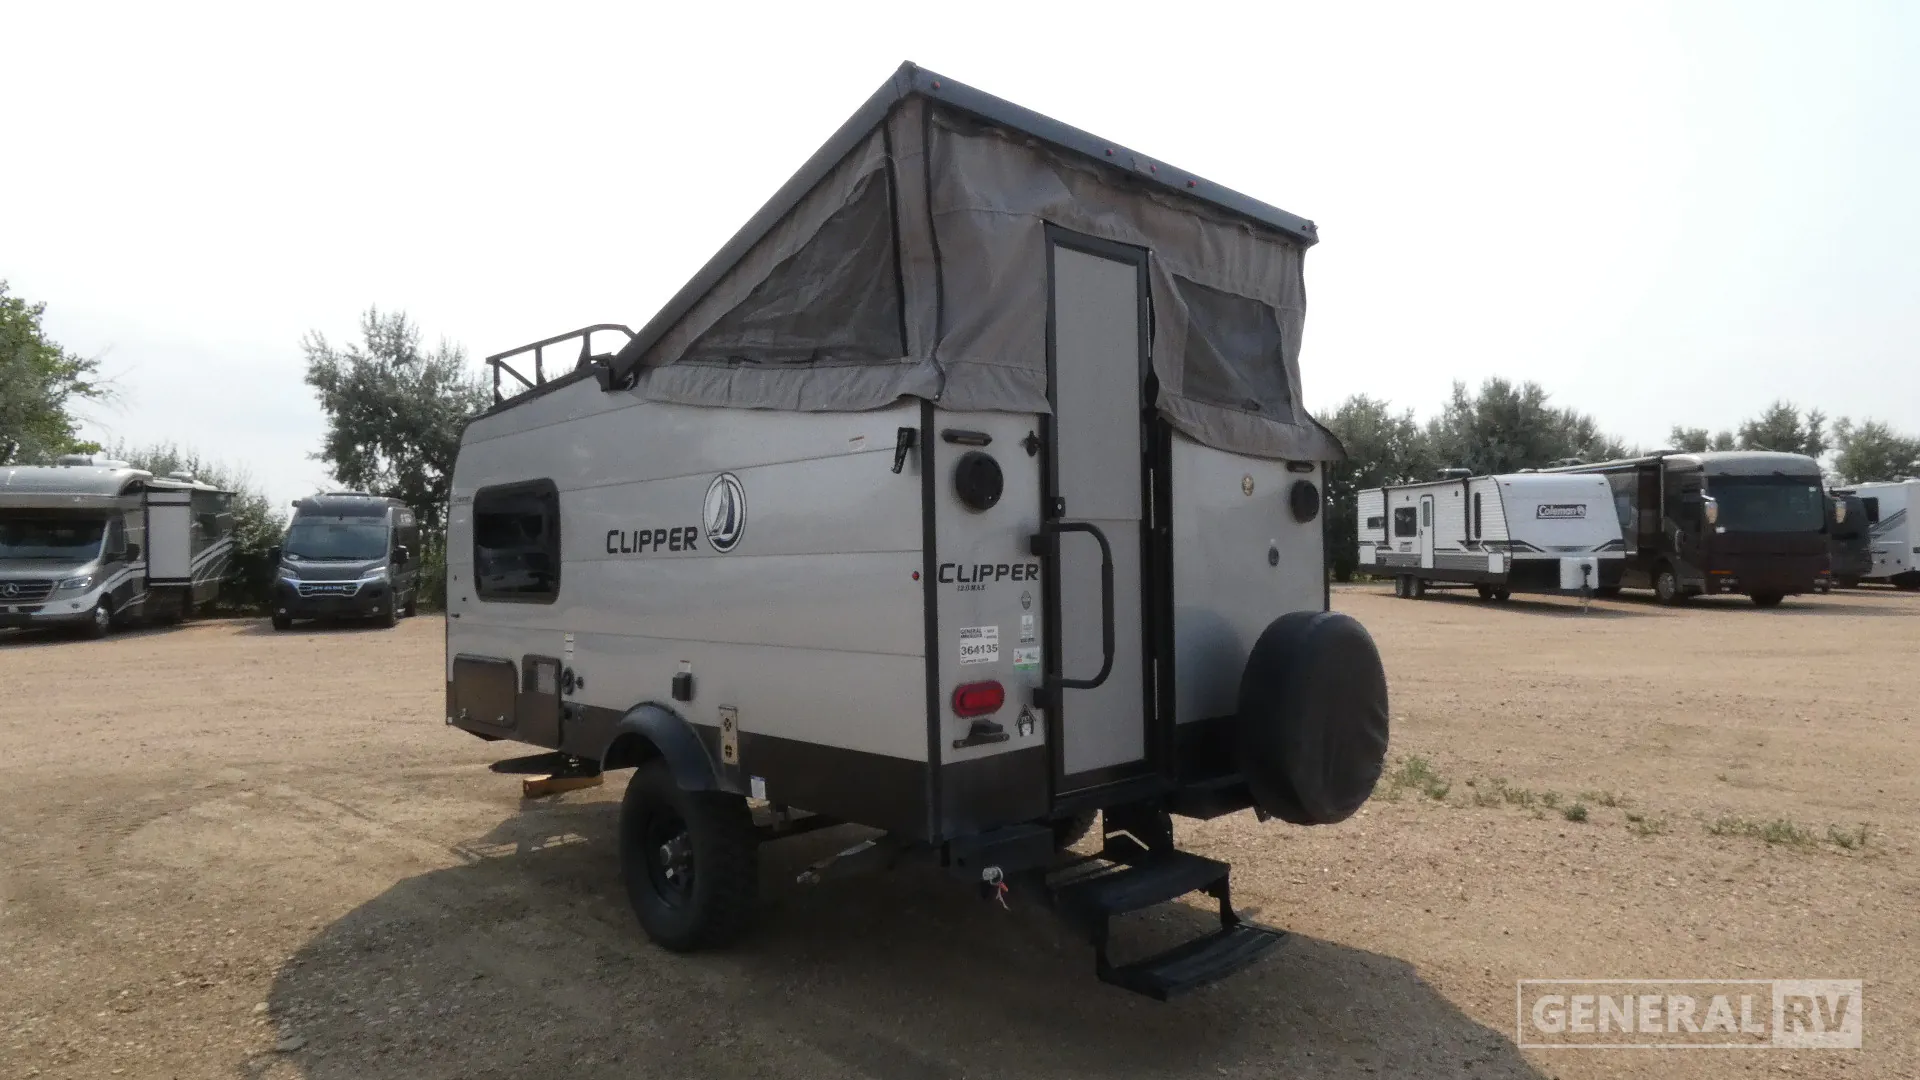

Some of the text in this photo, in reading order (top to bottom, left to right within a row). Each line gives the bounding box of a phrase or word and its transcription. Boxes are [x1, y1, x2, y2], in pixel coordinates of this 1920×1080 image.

[1539, 505, 1577, 516] Coleman
[606, 526, 698, 554] CLIPPER
[938, 563, 1039, 583] CLIPPER
[961, 643, 998, 656] 364135
